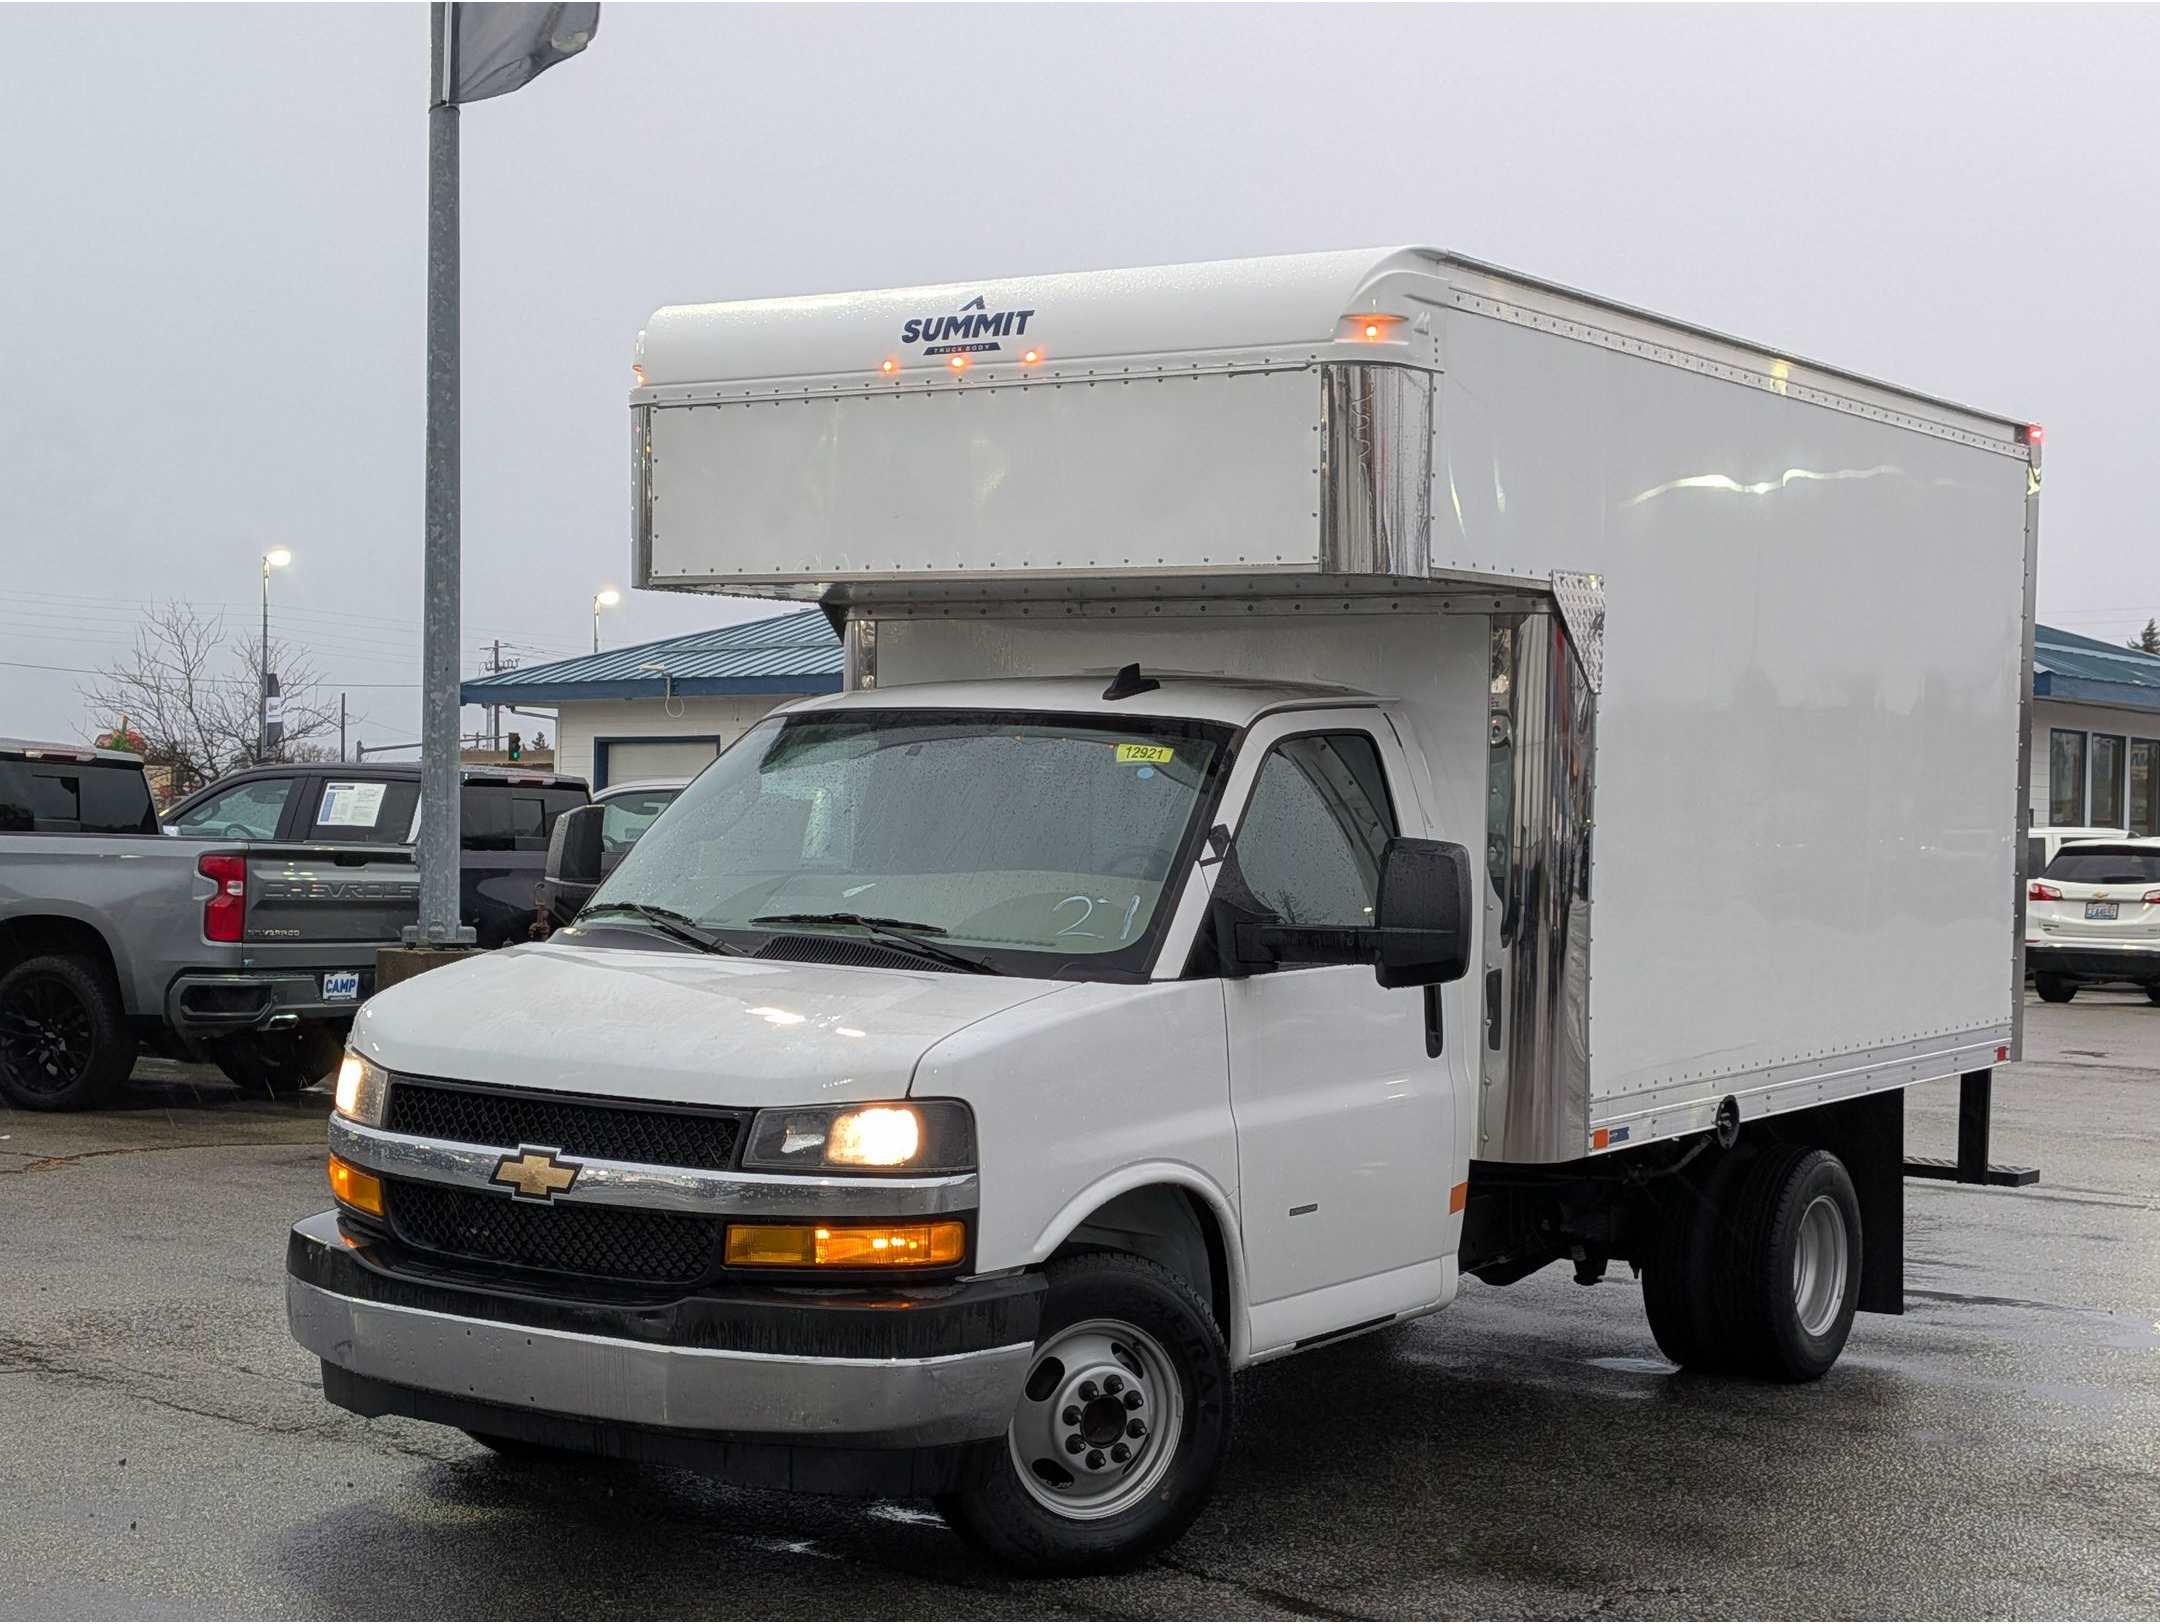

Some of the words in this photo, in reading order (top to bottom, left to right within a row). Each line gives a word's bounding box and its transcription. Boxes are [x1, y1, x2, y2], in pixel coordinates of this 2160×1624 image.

[901, 310, 1035, 343] SUMMIT
[965, 344, 990, 352] BODY
[1125, 746, 1163, 760] 12921
[264, 884, 419, 898] CHEVROLE
[326, 979, 356, 993] CAMP
